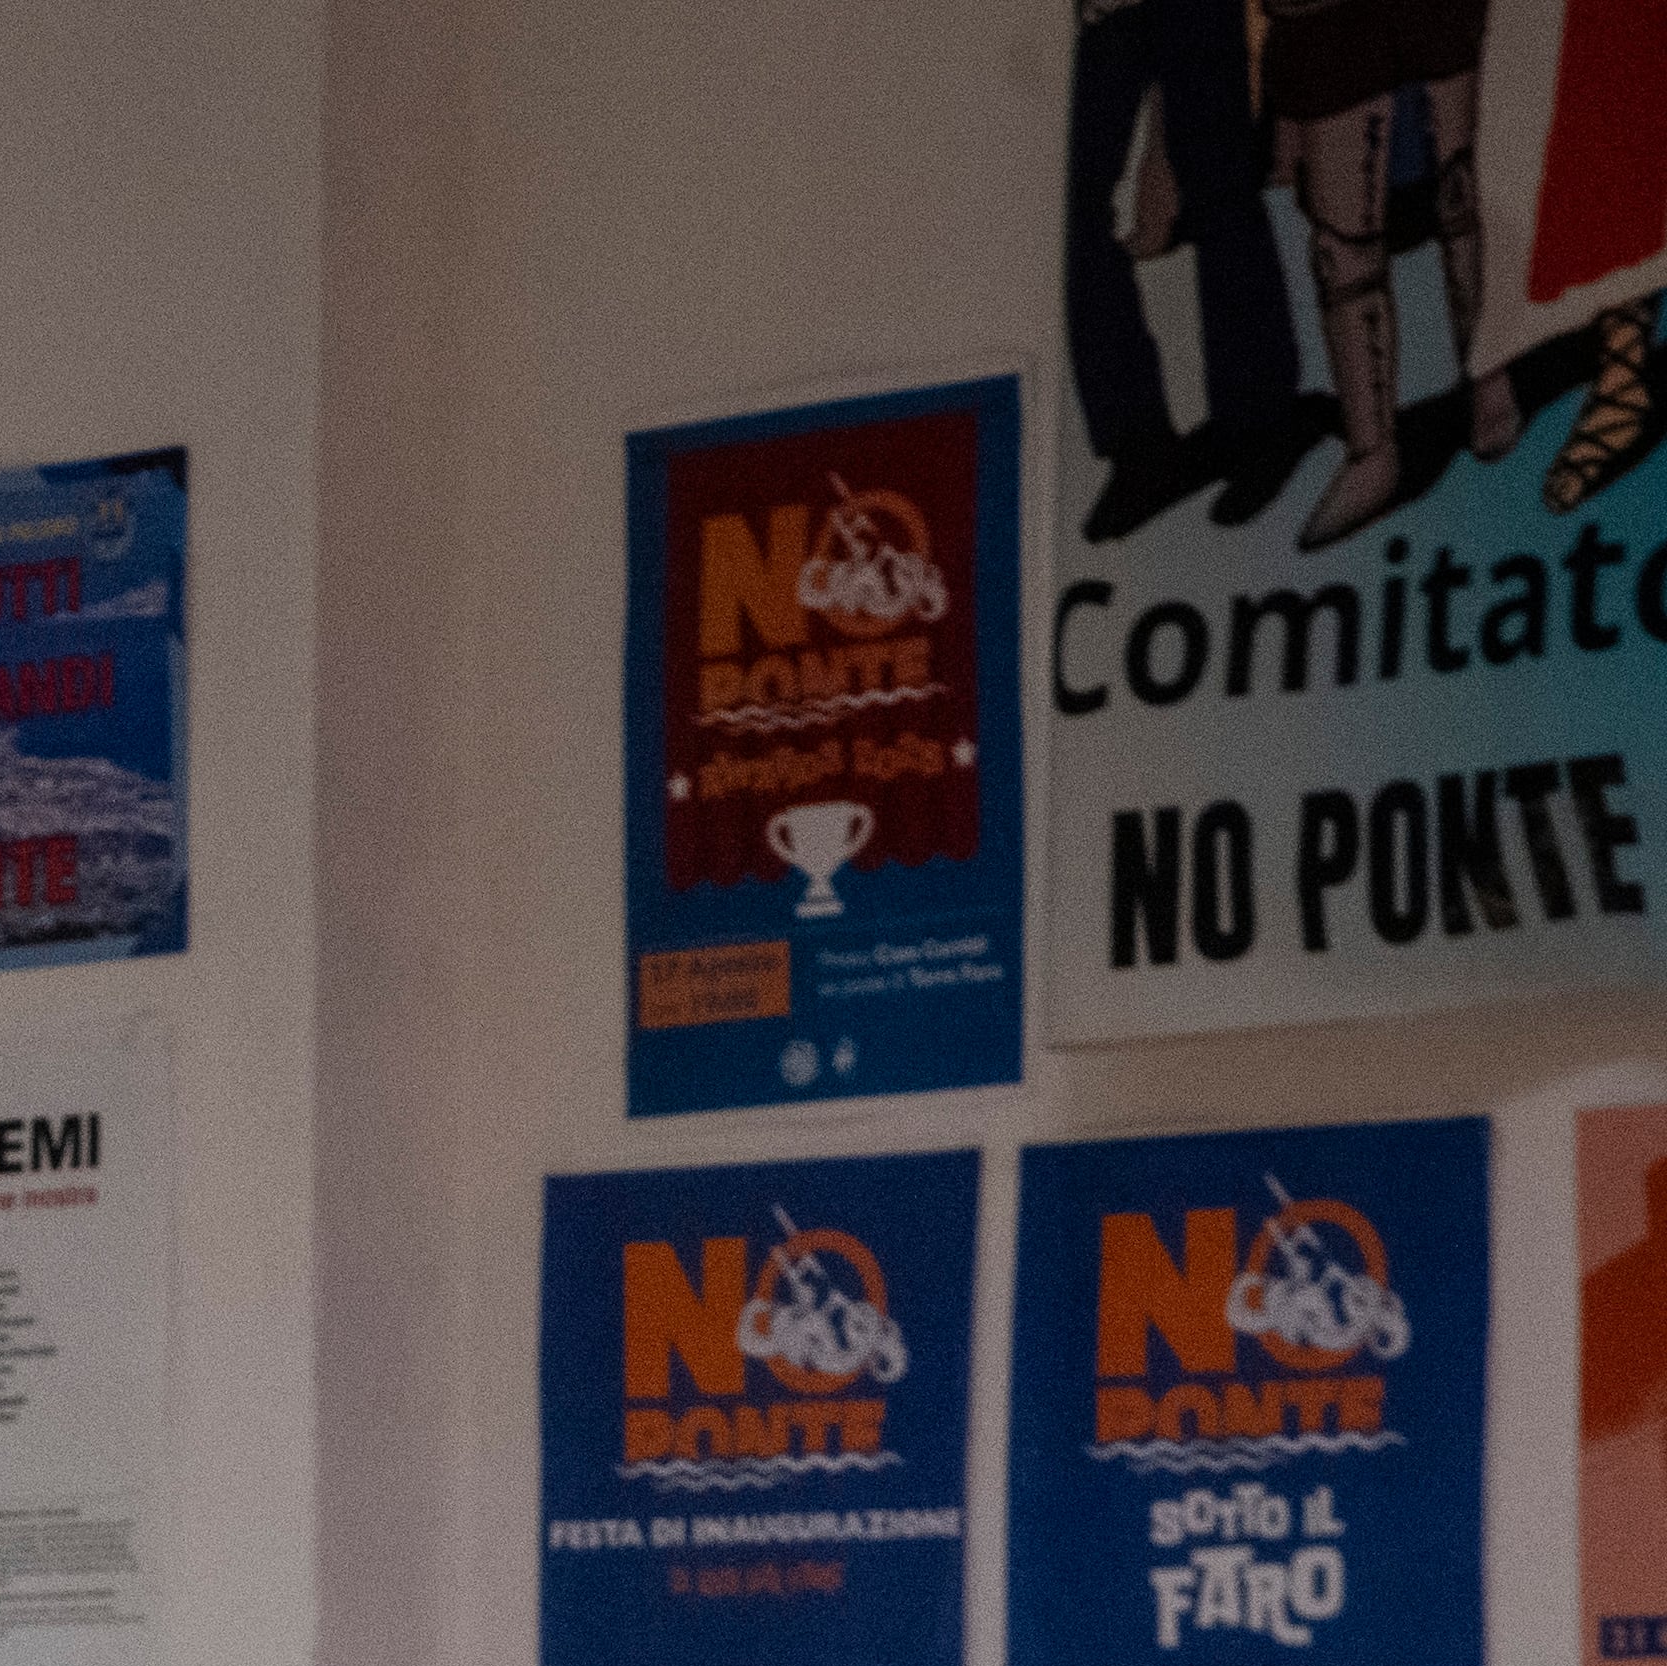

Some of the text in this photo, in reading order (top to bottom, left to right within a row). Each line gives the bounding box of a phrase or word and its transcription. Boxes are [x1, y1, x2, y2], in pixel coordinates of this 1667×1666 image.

[699, 487, 933, 656] NO
[698, 636, 932, 714] PONTE
[1110, 754, 1645, 969] NO PONTE
[623, 1227, 889, 1396] NO
[1098, 1199, 1389, 1374] NO
[622, 1400, 888, 1466] PONTE
[1095, 1376, 1386, 1444] PONTE
[549, 1507, 961, 1550] FESTA DI INAUGURAZIONE
[1151, 1481, 1346, 1546] SOTTO IL
[1149, 1547, 1346, 1648] FARO
